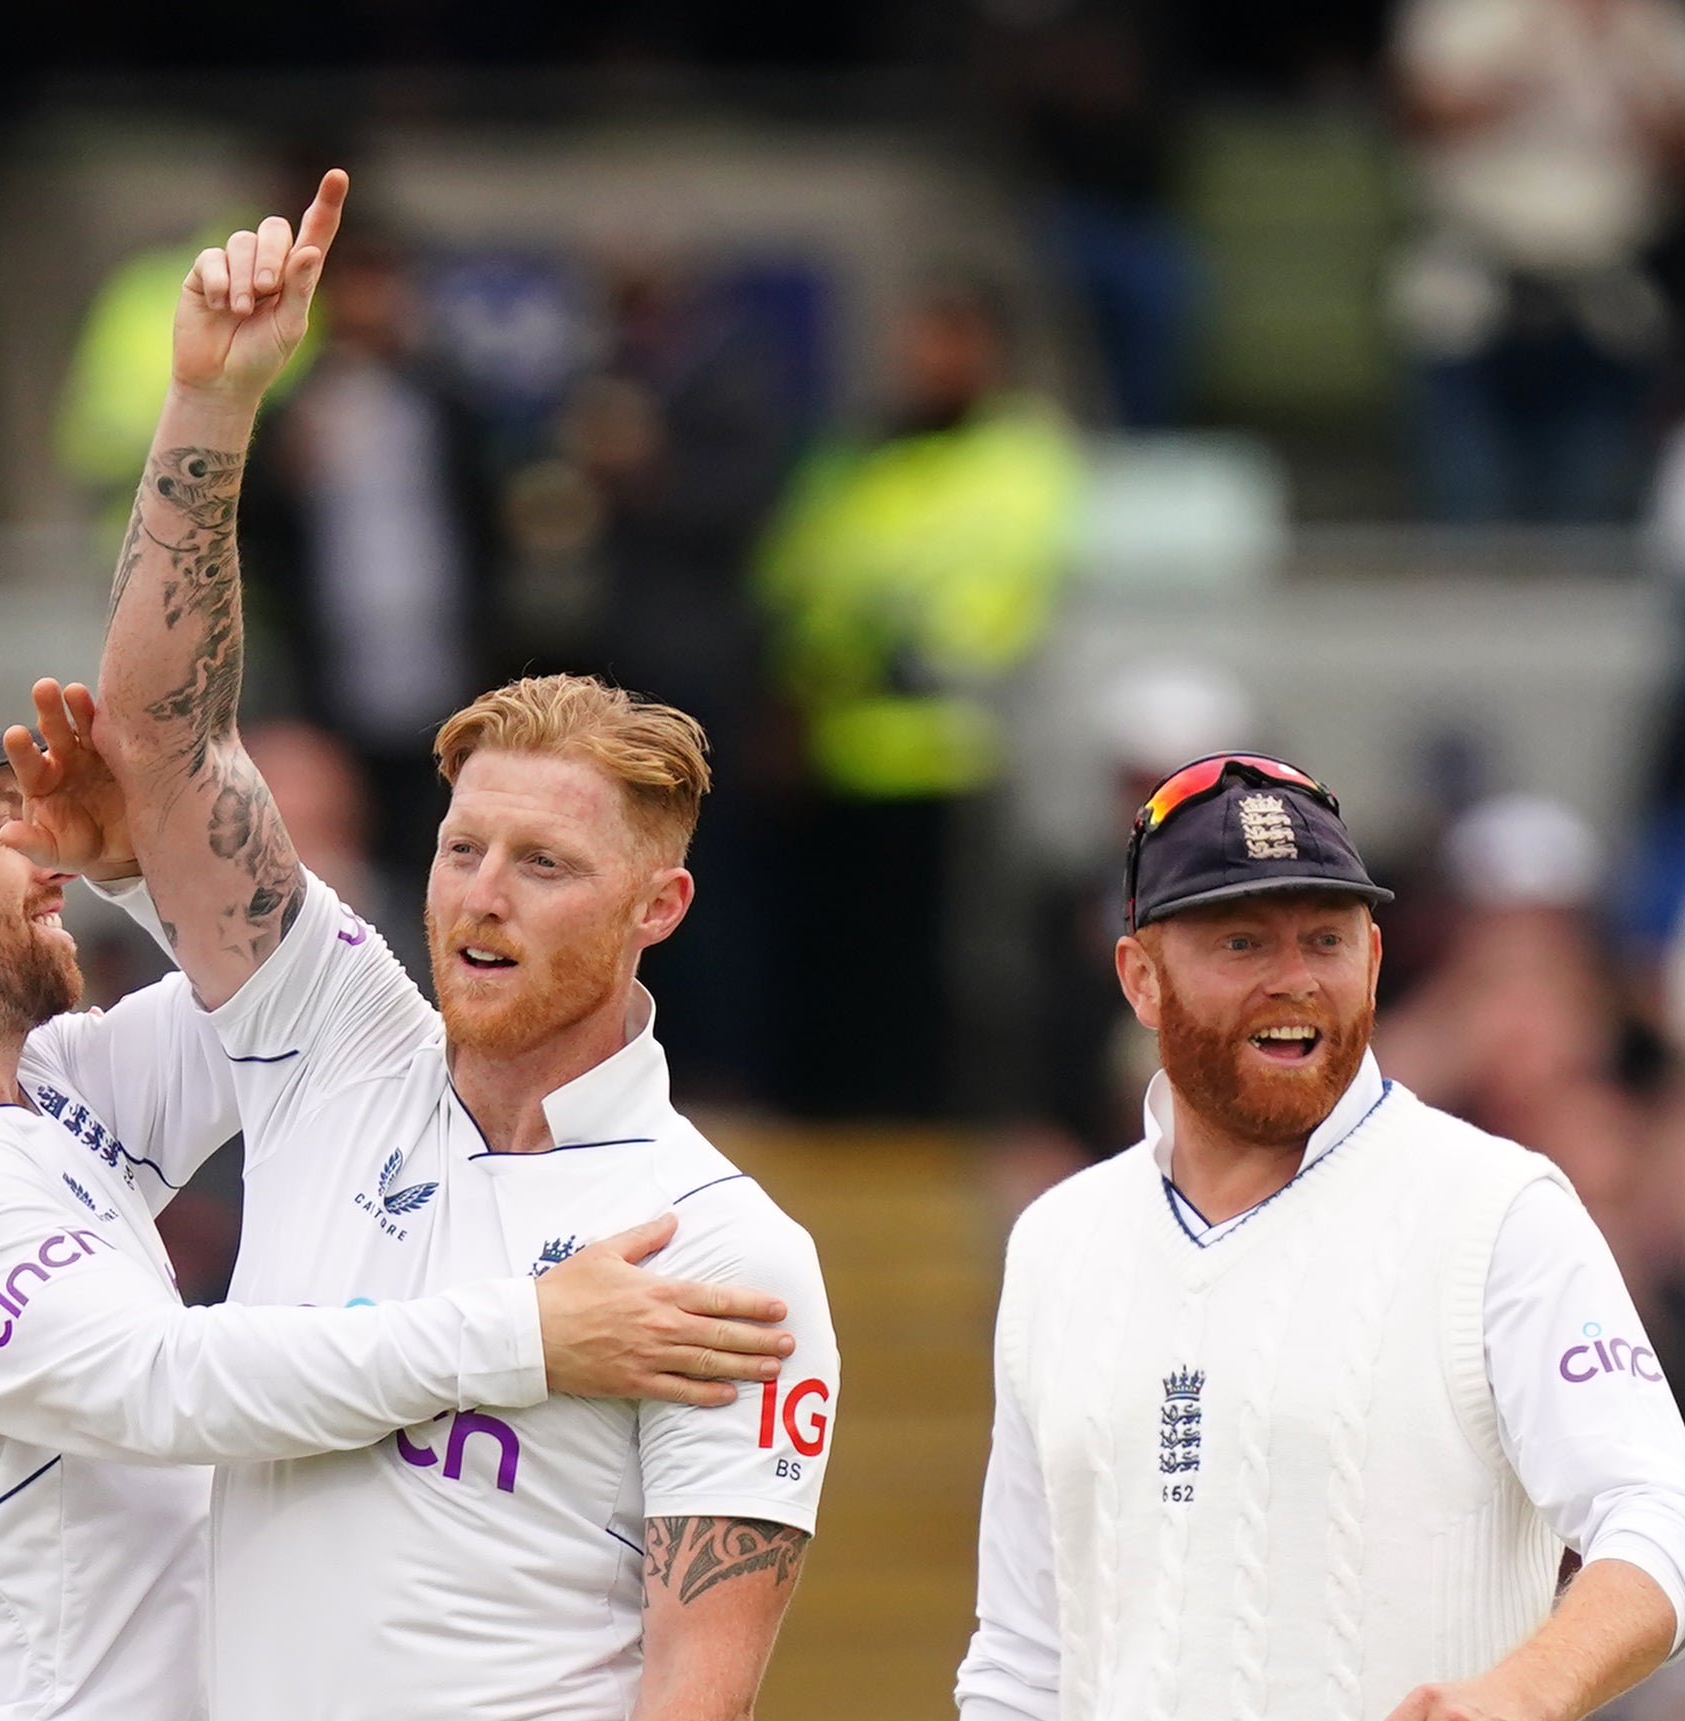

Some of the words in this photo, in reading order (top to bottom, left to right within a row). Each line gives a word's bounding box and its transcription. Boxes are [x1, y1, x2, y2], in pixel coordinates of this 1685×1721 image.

[354, 1192, 408, 1242] CATORE
[1559, 1321, 1665, 1383] cinc
[758, 1378, 830, 1458] IG
[774, 1459, 802, 1482] BS
